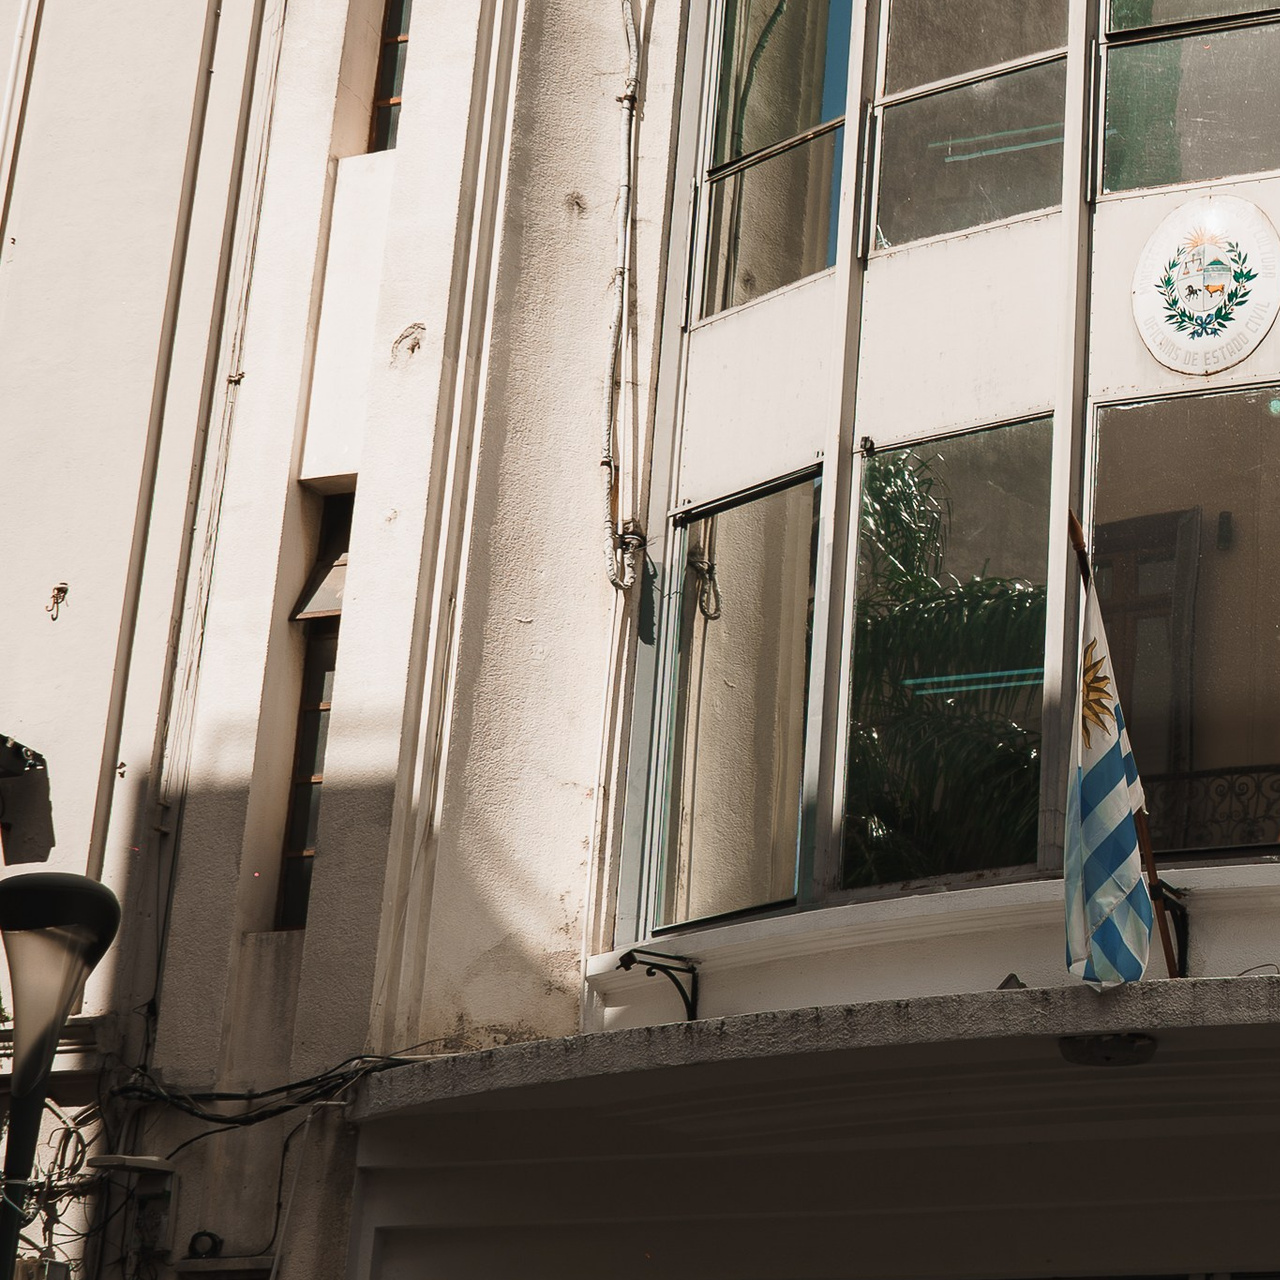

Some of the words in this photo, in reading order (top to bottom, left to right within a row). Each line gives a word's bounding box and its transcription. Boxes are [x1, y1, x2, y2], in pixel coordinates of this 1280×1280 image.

[1182, 350, 1200, 367] DE
[1203, 332, 1250, 368] ESTADO
[1244, 301, 1271, 333] CIVIL
